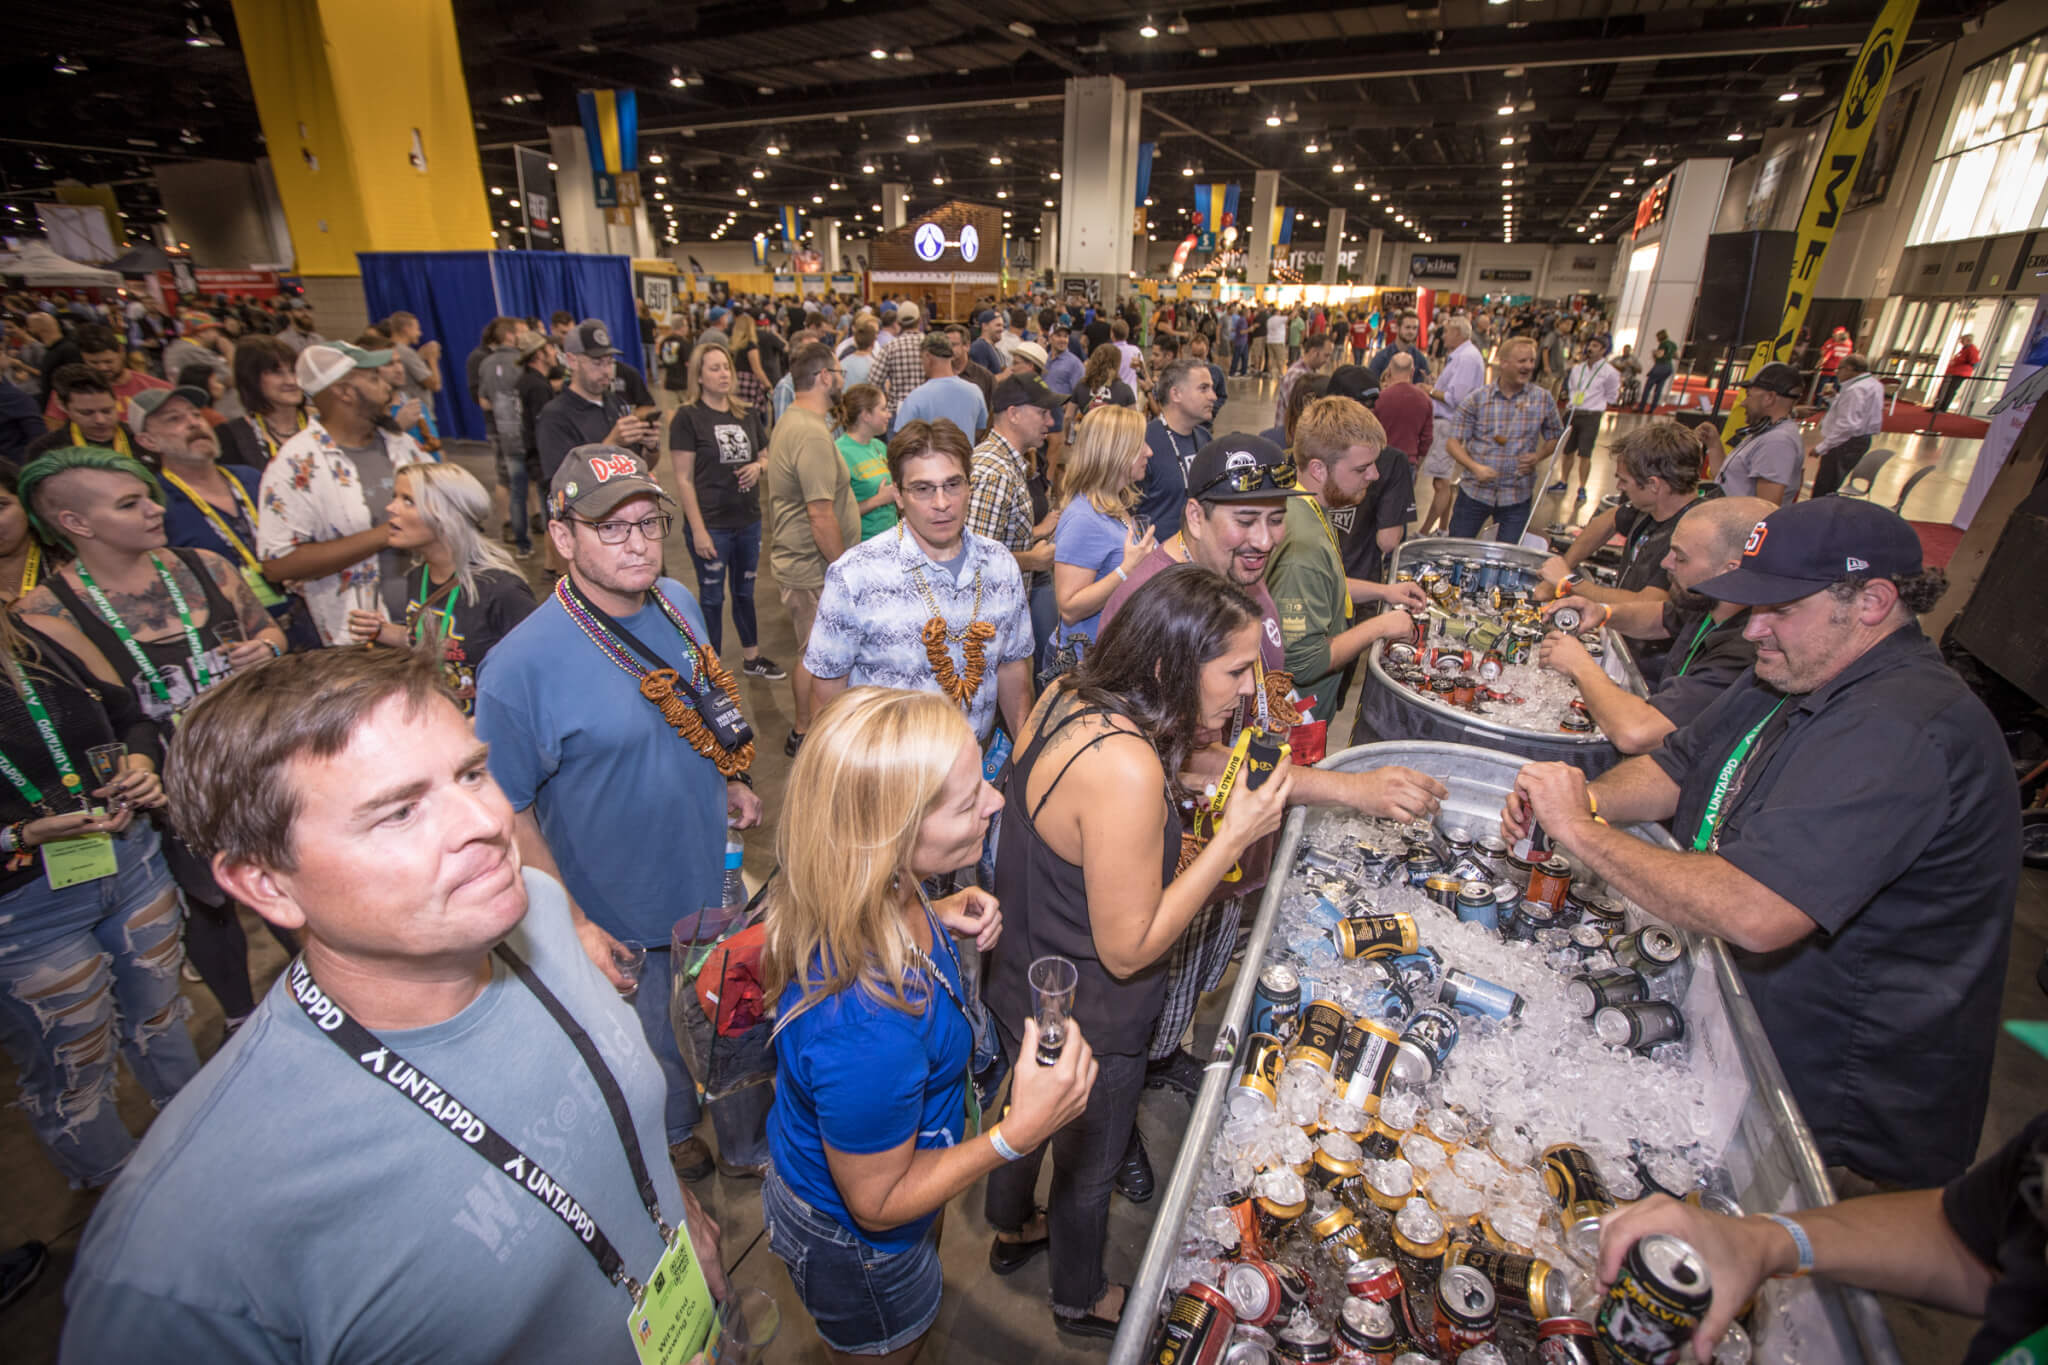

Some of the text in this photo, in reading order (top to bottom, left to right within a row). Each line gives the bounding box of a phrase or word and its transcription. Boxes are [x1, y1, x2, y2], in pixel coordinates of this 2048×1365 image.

[37, 718, 69, 768] UNTAPPD
[1707, 758, 1738, 812] UNTAPPD
[386, 1060, 486, 1144] UNTAPPD
[526, 1167, 596, 1243] UNTAPPD
[675, 1296, 688, 1322] End
